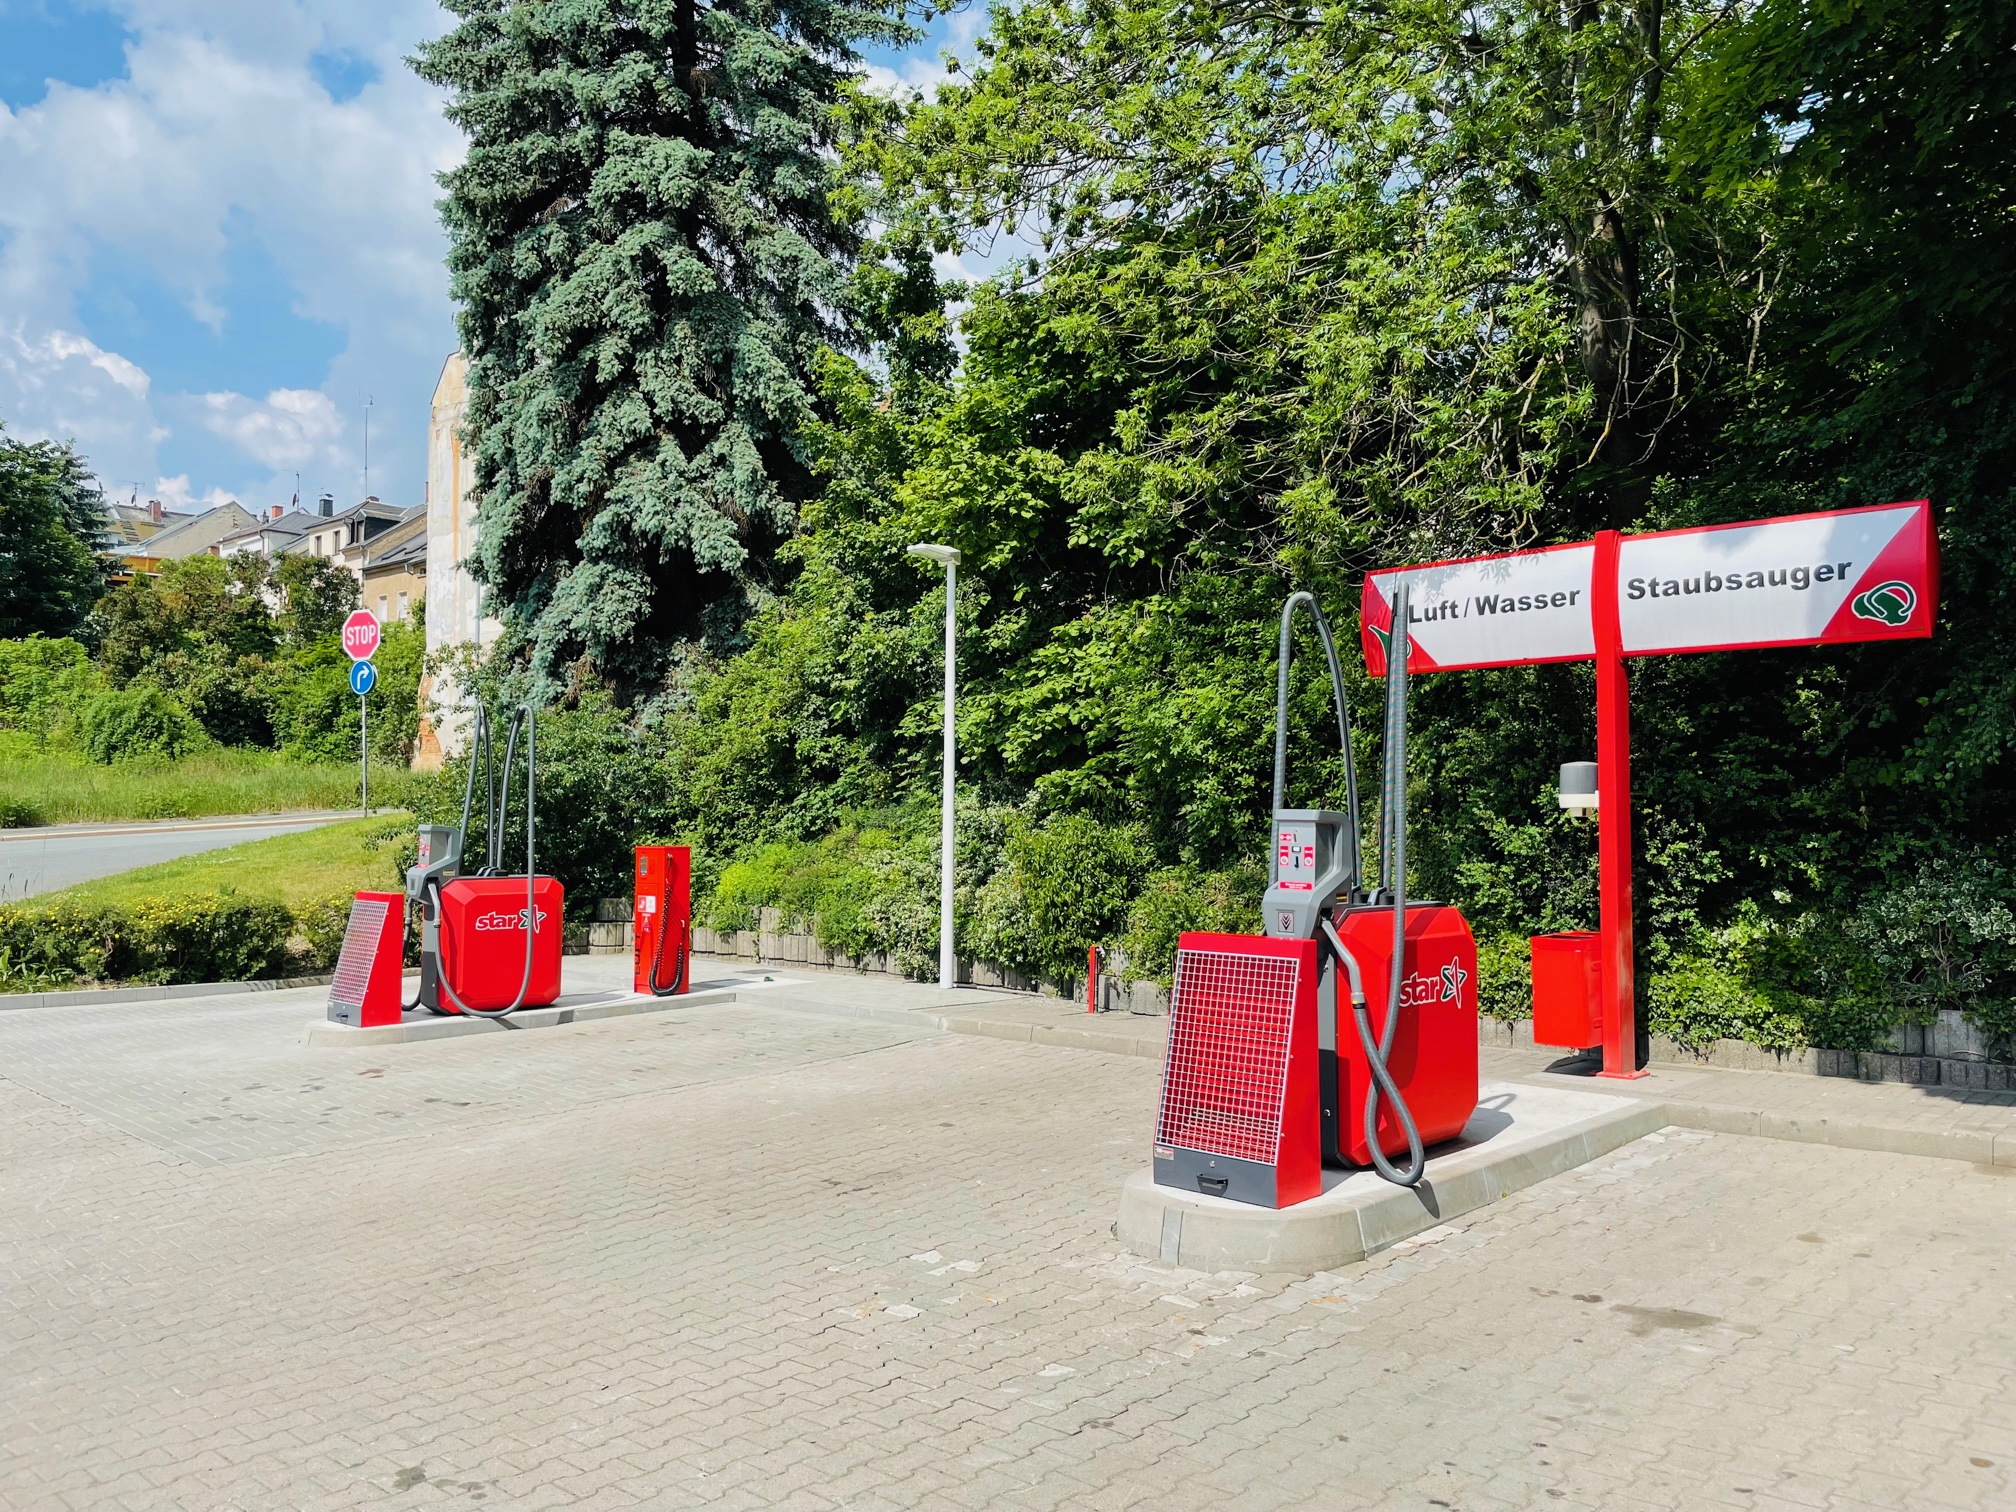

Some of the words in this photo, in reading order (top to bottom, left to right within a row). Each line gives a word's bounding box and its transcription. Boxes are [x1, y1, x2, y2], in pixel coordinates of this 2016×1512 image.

[1627, 561, 1853, 600] Staubsauger
[1408, 599, 1459, 623] Luft
[1475, 589, 1581, 616] Wasser
[346, 624, 376, 646] STOP
[475, 911, 518, 931] star
[1399, 971, 1440, 1007] star
